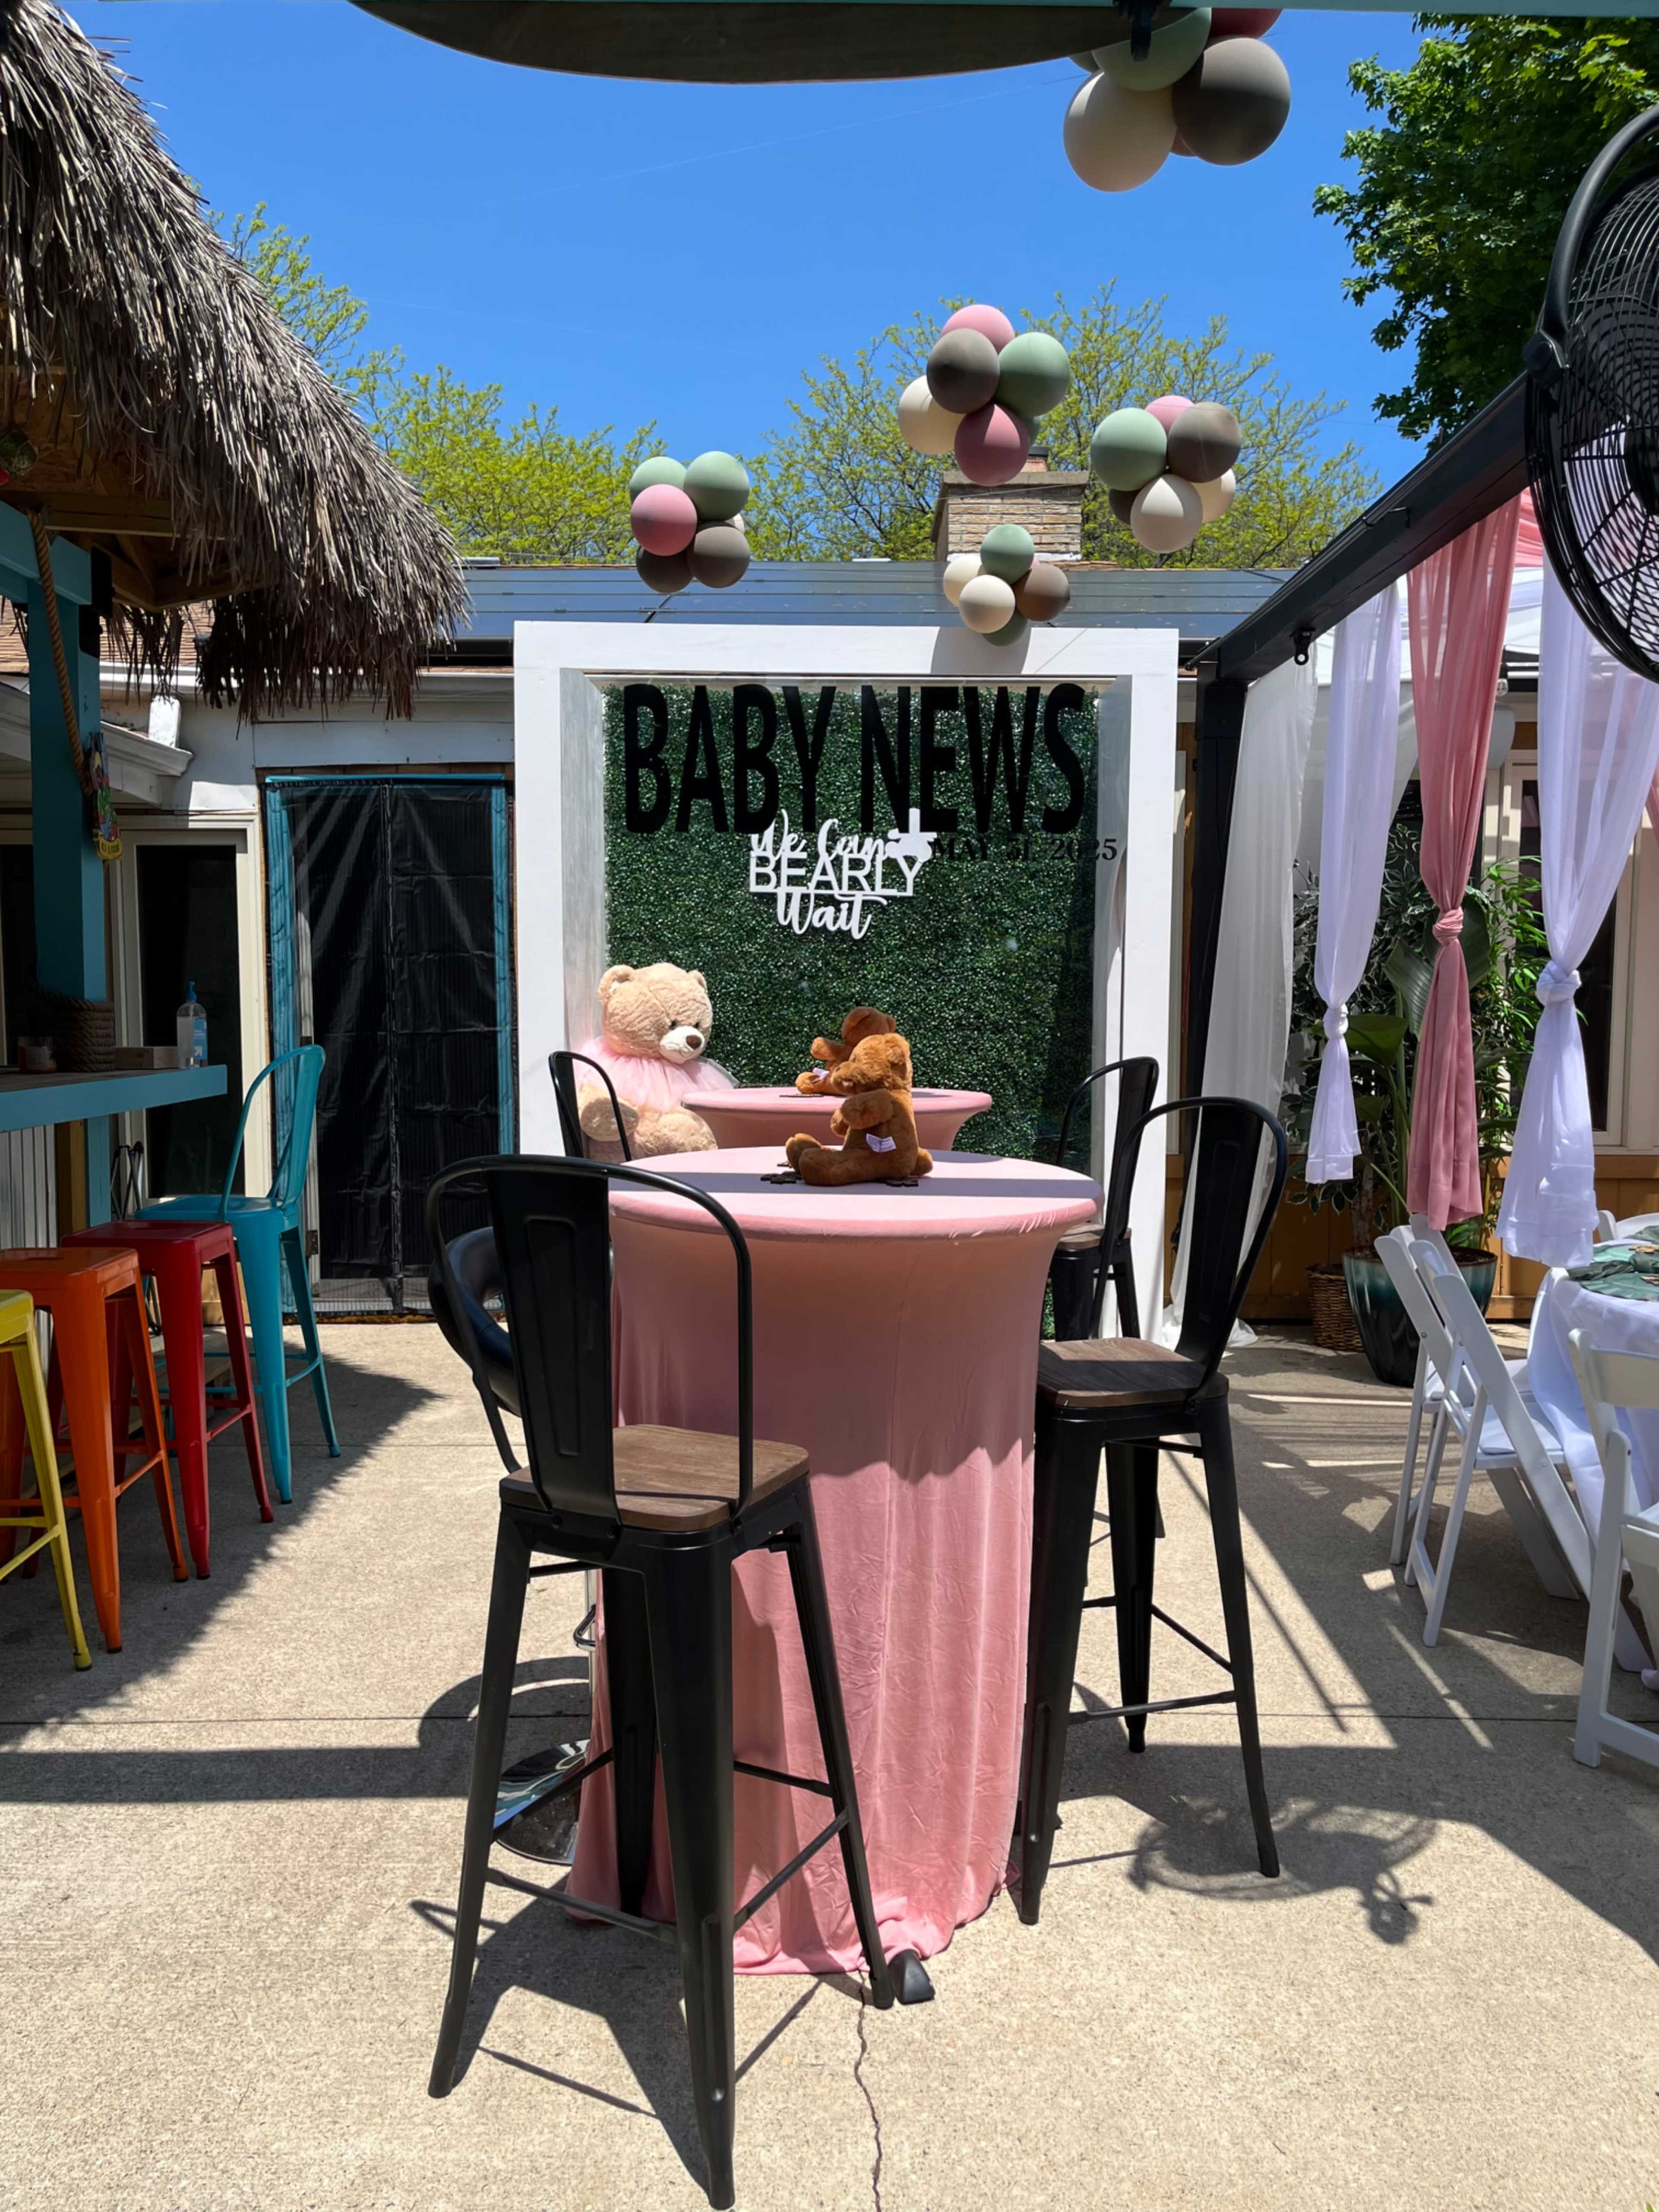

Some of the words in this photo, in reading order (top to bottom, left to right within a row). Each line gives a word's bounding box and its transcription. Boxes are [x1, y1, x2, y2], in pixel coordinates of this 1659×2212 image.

[624, 684, 836, 833] BABY
[861, 683, 1086, 833] NEWS
[750, 809, 807, 860] We
[928, 838, 987, 860] MAY
[1050, 838, 1118, 861] 2025
[750, 851, 925, 896] BEARLY
[777, 885, 887, 940] Wait
